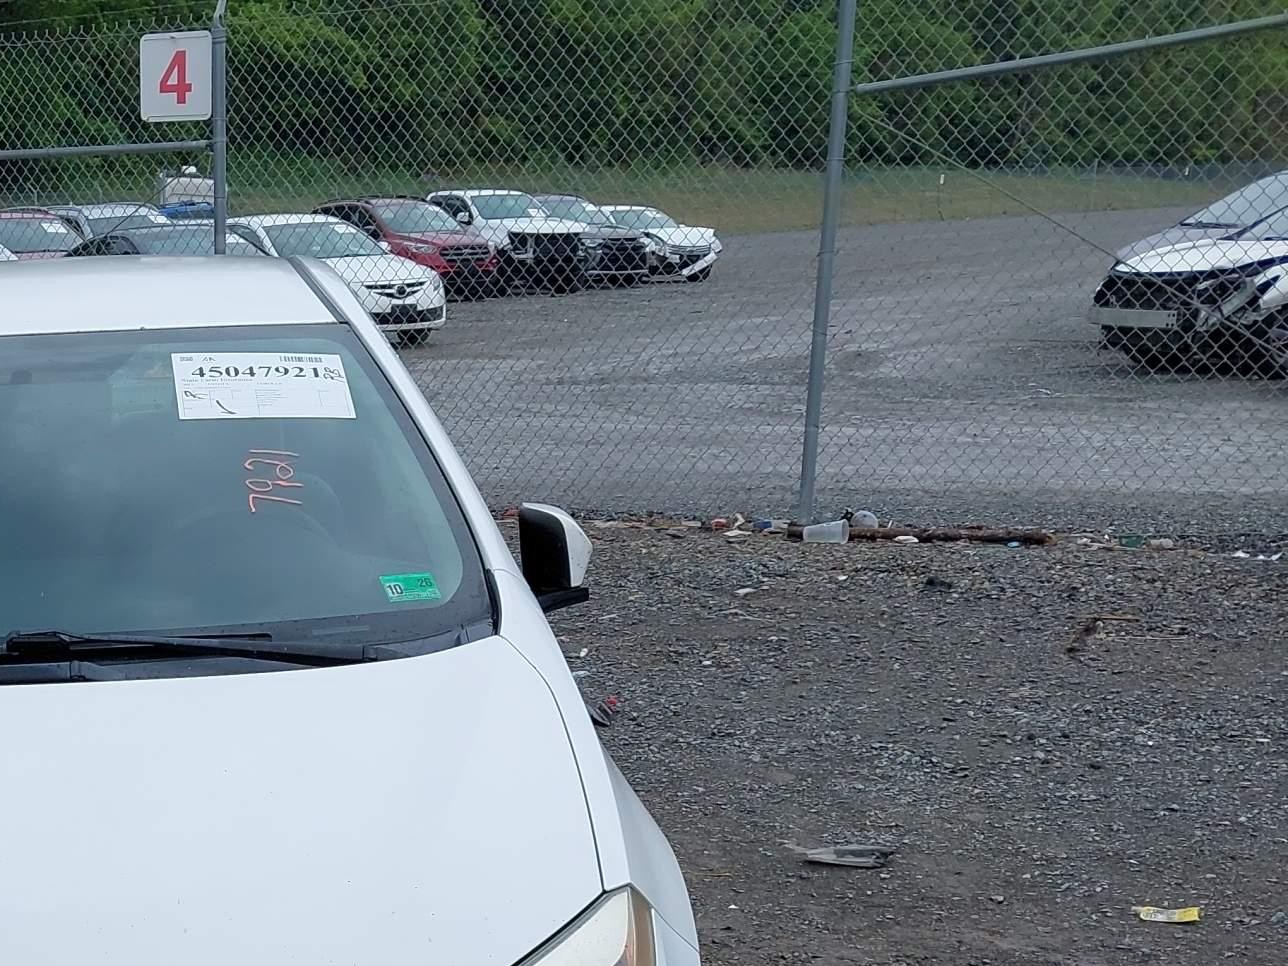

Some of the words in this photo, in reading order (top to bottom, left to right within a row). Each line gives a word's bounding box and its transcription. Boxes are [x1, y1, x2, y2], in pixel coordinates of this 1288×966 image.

[159, 49, 192, 105] 4
[191, 366, 320, 378] 45047921
[244, 449, 304, 513] 7921
[386, 583, 404, 596] 10
